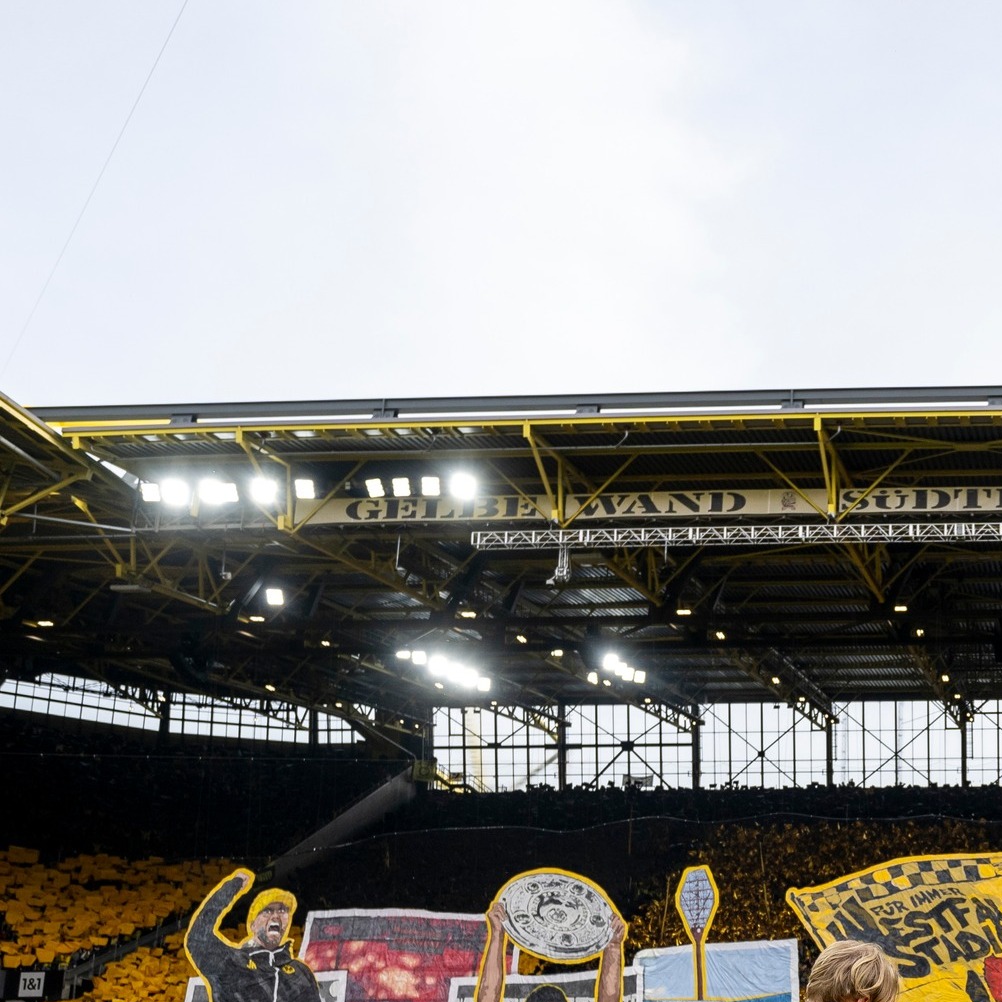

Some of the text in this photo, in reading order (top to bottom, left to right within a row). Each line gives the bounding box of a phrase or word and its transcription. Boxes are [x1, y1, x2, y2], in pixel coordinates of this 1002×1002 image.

[345, 496, 538, 520] GELBE
[573, 491, 747, 516] WAND
[909, 887, 965, 908] IMMER
[22, 977, 42, 990] 1&1
